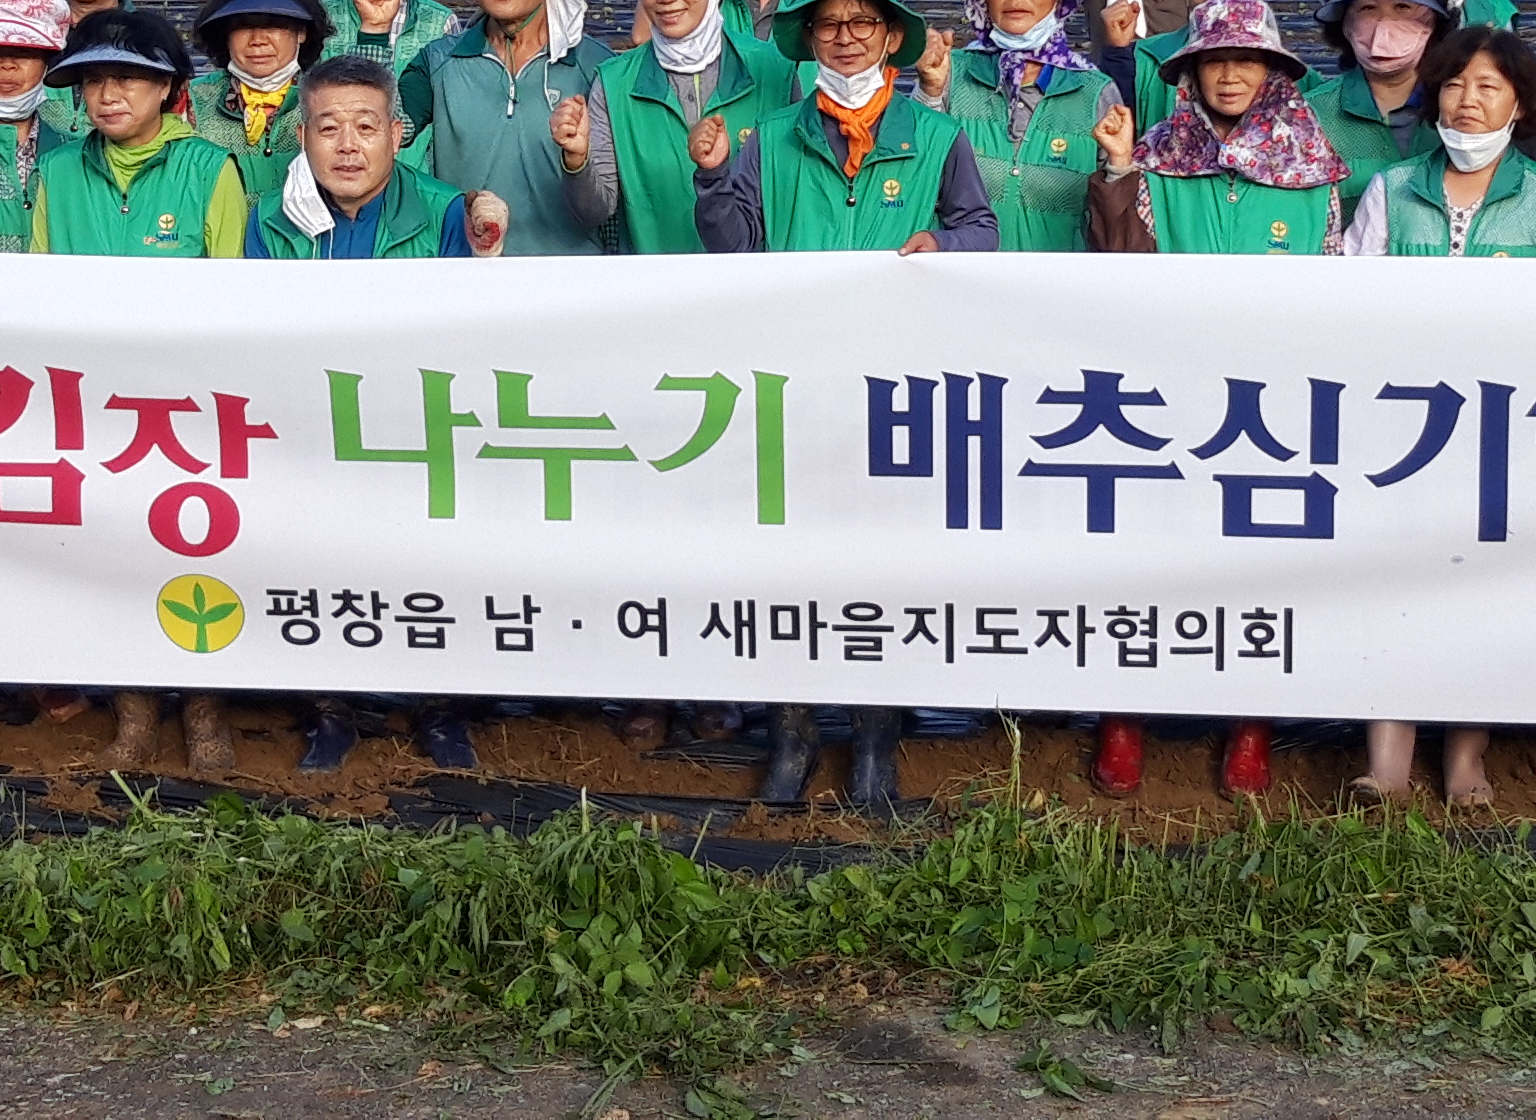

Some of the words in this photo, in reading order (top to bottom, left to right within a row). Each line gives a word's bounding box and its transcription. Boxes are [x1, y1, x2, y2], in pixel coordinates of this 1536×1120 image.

[325, 369, 790, 525] 나누기
[265, 588, 456, 650] 평창읍
[485, 594, 542, 653] 남
[616, 597, 669, 657] 여
[699, 598, 1294, 674] 새마을지도자협의회
